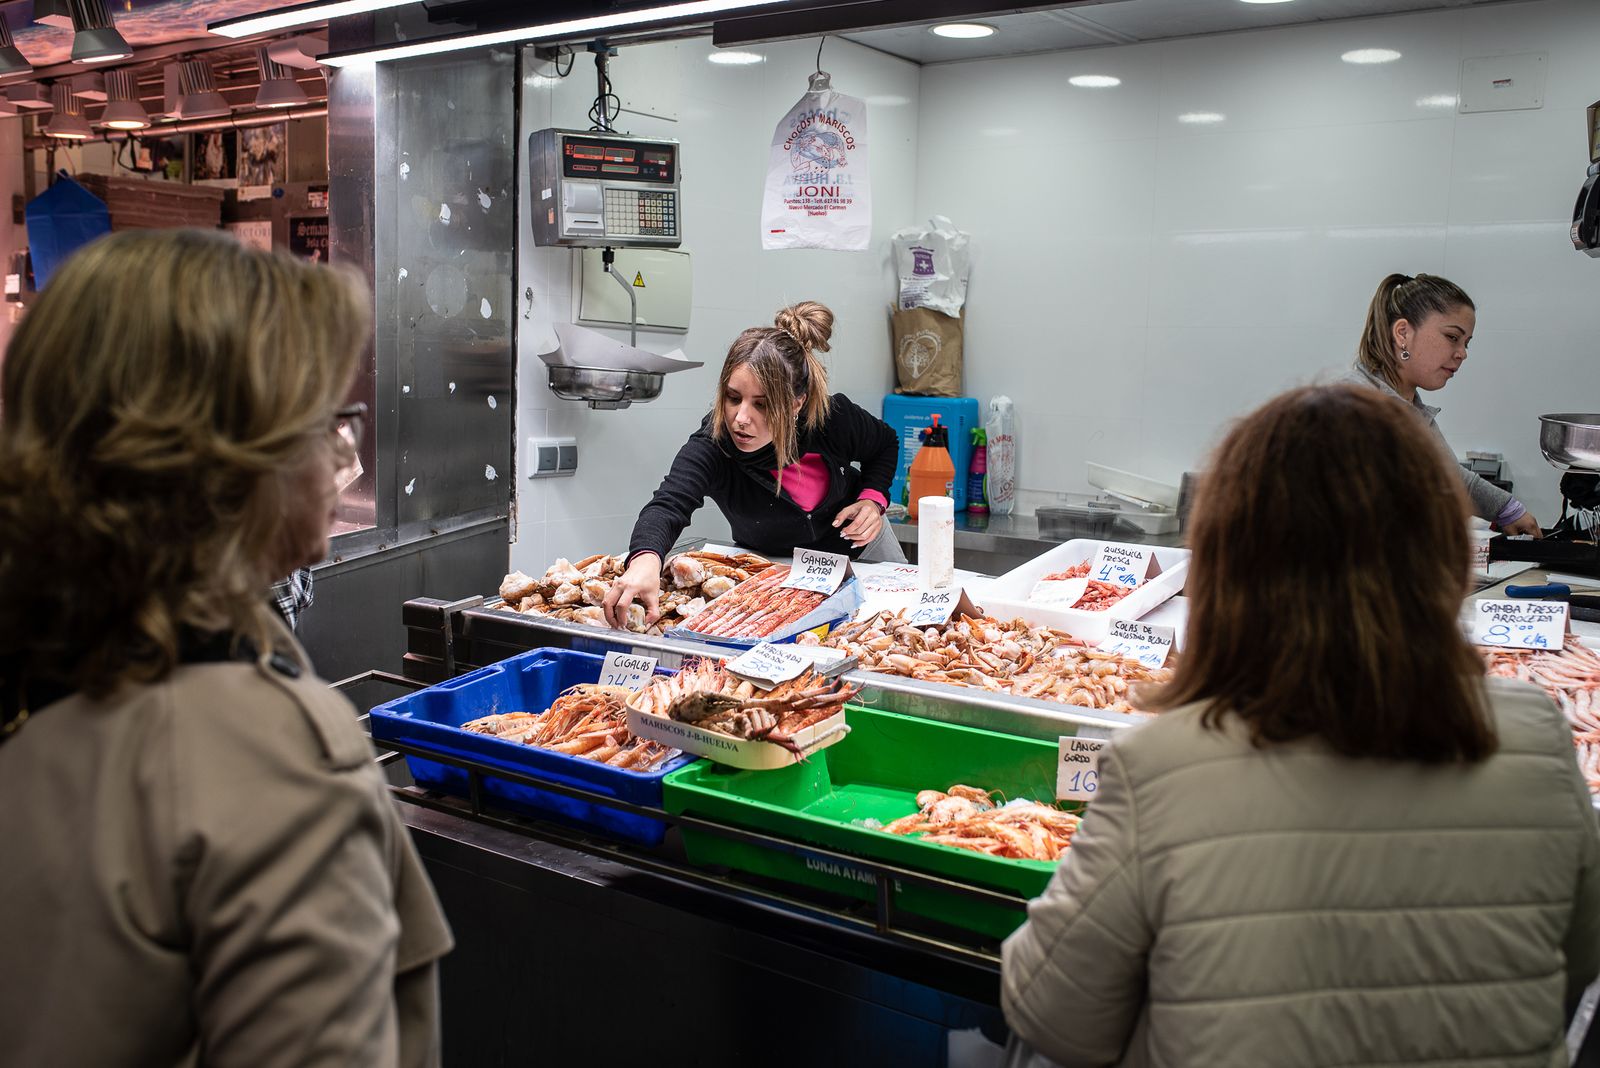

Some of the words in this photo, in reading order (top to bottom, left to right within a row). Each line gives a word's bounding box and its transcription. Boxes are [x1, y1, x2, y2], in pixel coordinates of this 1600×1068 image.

[783, 116, 811, 151] CHOCOS
[818, 113, 856, 151] MARISCOS
[796, 186, 840, 197] JONI
[801, 551, 838, 567] GAMBÓN
[1103, 554, 1130, 565] FRESCA
[806, 565, 832, 576] EXTRA
[920, 592, 950, 605] BOCAS
[1481, 602, 1521, 614] GAMBA
[1526, 603, 1564, 614] FRESCA
[1492, 613, 1553, 623] ARROCERA
[1115, 620, 1138, 633] COLAS
[1143, 625, 1153, 635] DE
[761, 643, 803, 664] MARISCADA
[614, 655, 651, 671] CIGALAS
[640, 716, 686, 737] MARISCOS
[1070, 740, 1104, 752] LANGO
[1063, 753, 1091, 763] GORDO
[1068, 770, 1098, 793] 16
